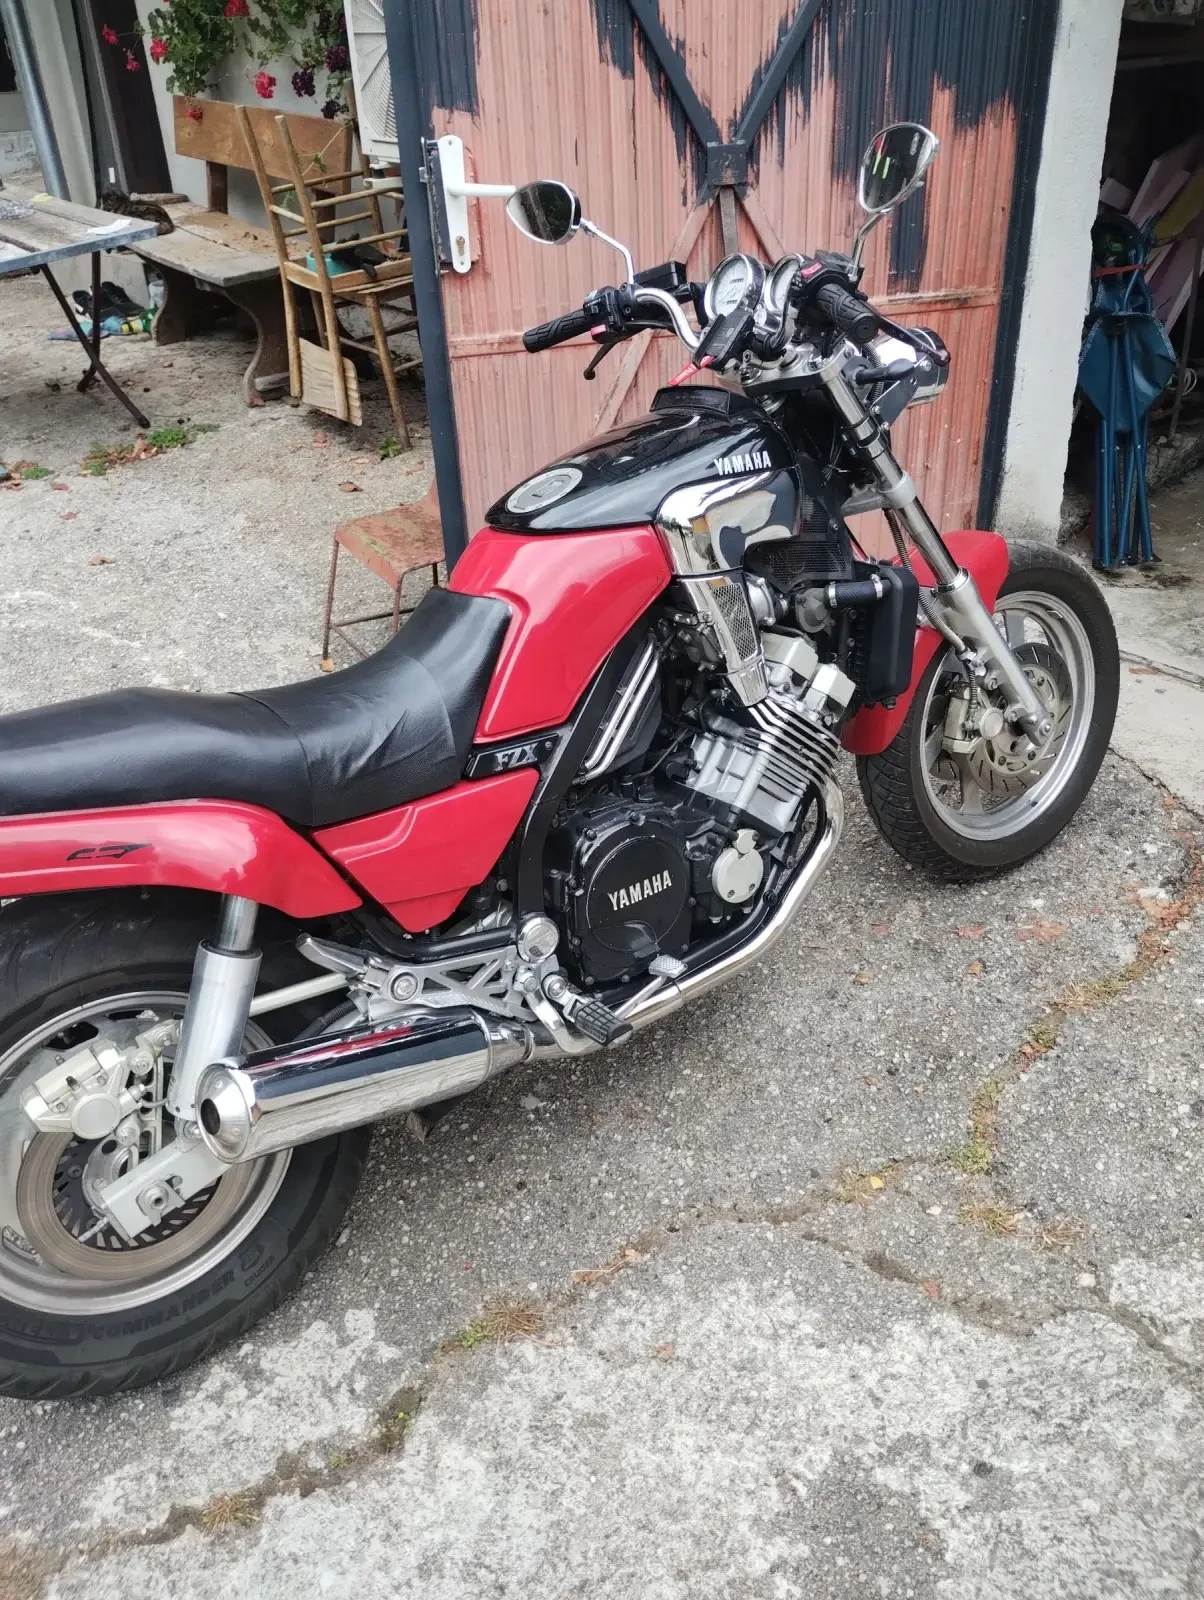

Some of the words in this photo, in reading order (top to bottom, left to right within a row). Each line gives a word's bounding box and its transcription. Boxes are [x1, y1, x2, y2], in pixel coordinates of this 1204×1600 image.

[713, 450, 772, 476] YAMAHA
[493, 742, 539, 772] FZX
[607, 869, 672, 911] YAMAHA
[244, 1254, 276, 1287] CRUISER
[92, 1269, 235, 1340] COMMANDER
